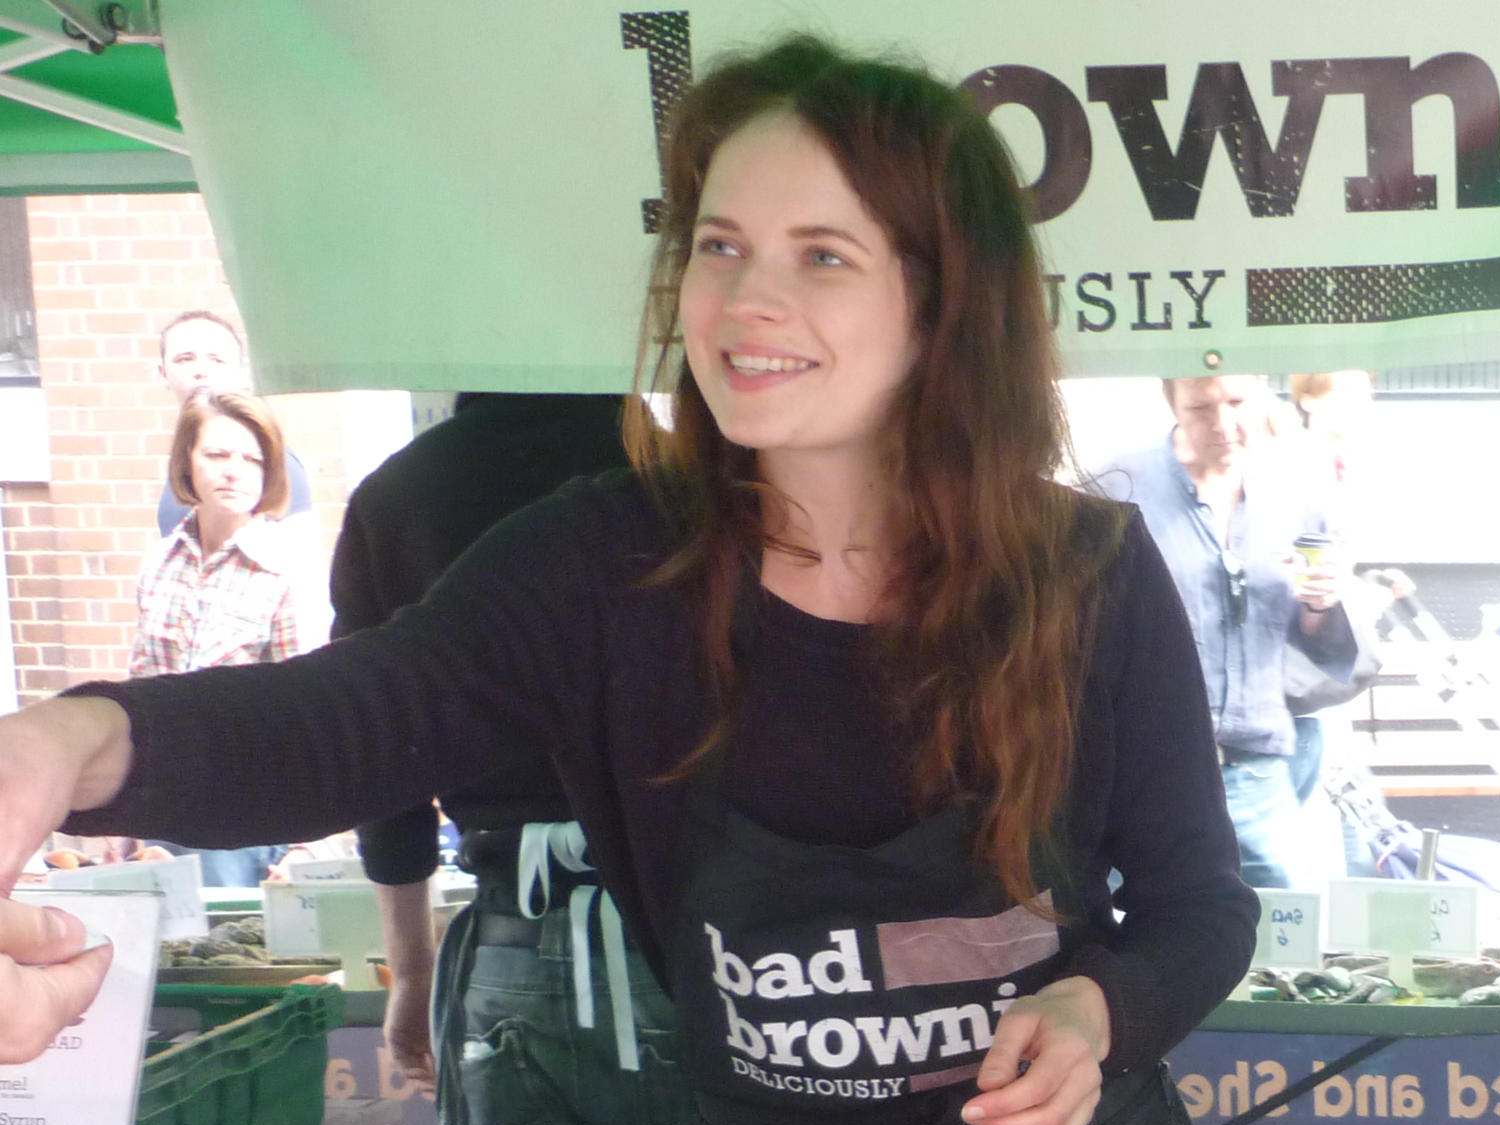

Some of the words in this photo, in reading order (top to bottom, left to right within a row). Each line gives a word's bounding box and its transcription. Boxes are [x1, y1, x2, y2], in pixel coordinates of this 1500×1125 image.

[704, 922, 873, 1000] bad
[719, 982, 1018, 1068] brown
[730, 1056, 906, 1099] DELICIOUSLY
